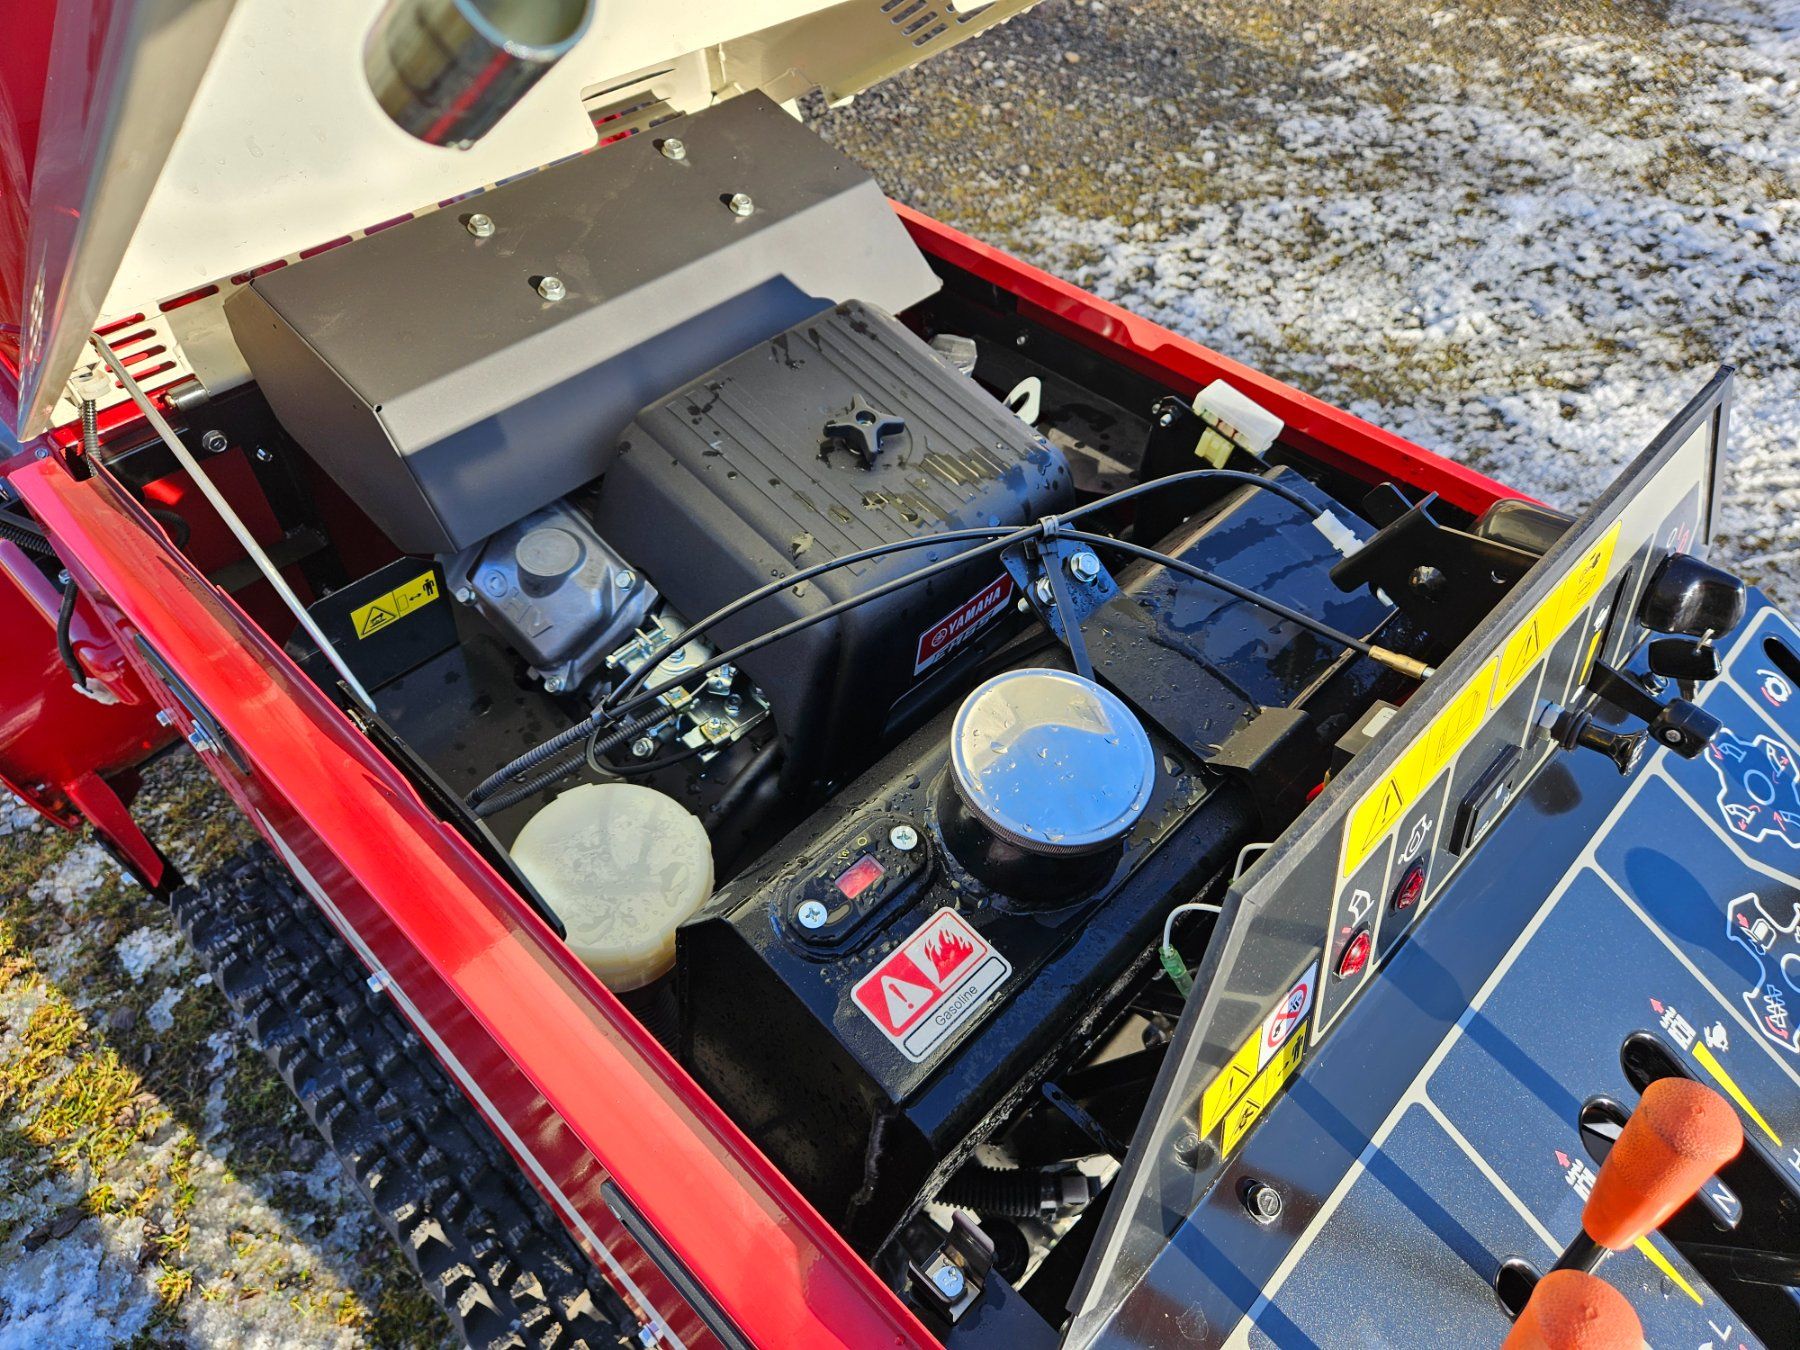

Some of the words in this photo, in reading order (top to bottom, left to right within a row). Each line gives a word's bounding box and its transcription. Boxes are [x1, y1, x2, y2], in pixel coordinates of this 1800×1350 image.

[949, 586, 1001, 634] YAMAHA
[935, 986, 978, 1025] Gasoline
[1712, 1183, 1737, 1215] N
[1708, 1319, 1732, 1342] L
